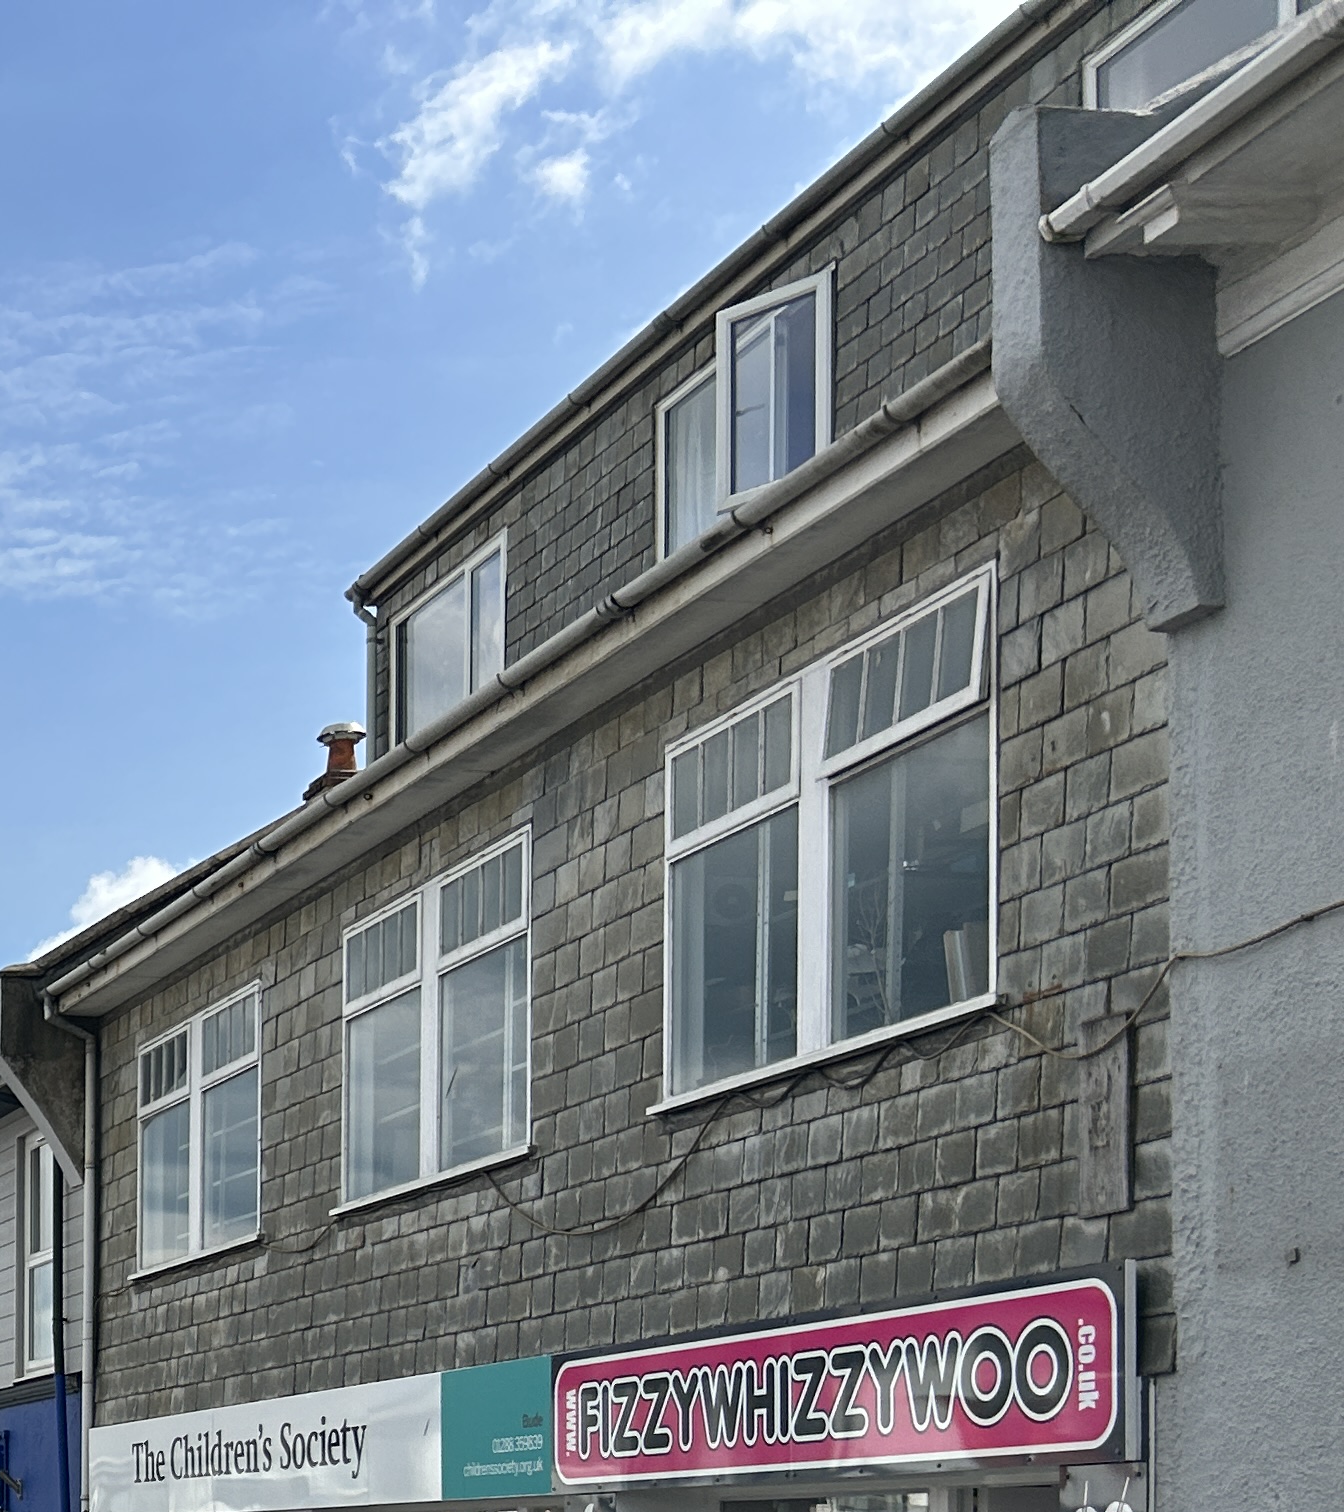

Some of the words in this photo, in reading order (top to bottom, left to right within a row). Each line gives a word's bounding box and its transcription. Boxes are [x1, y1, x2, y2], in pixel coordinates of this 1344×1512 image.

[521, 1413, 544, 1429] Bude
[578, 1317, 1074, 1458] FIZZYWHIZZYWOO
[1076, 1318, 1099, 1412] .co.uk
[132, 1440, 165, 1484] The
[170, 1424, 273, 1480] Children's
[280, 1416, 368, 1479] Society
